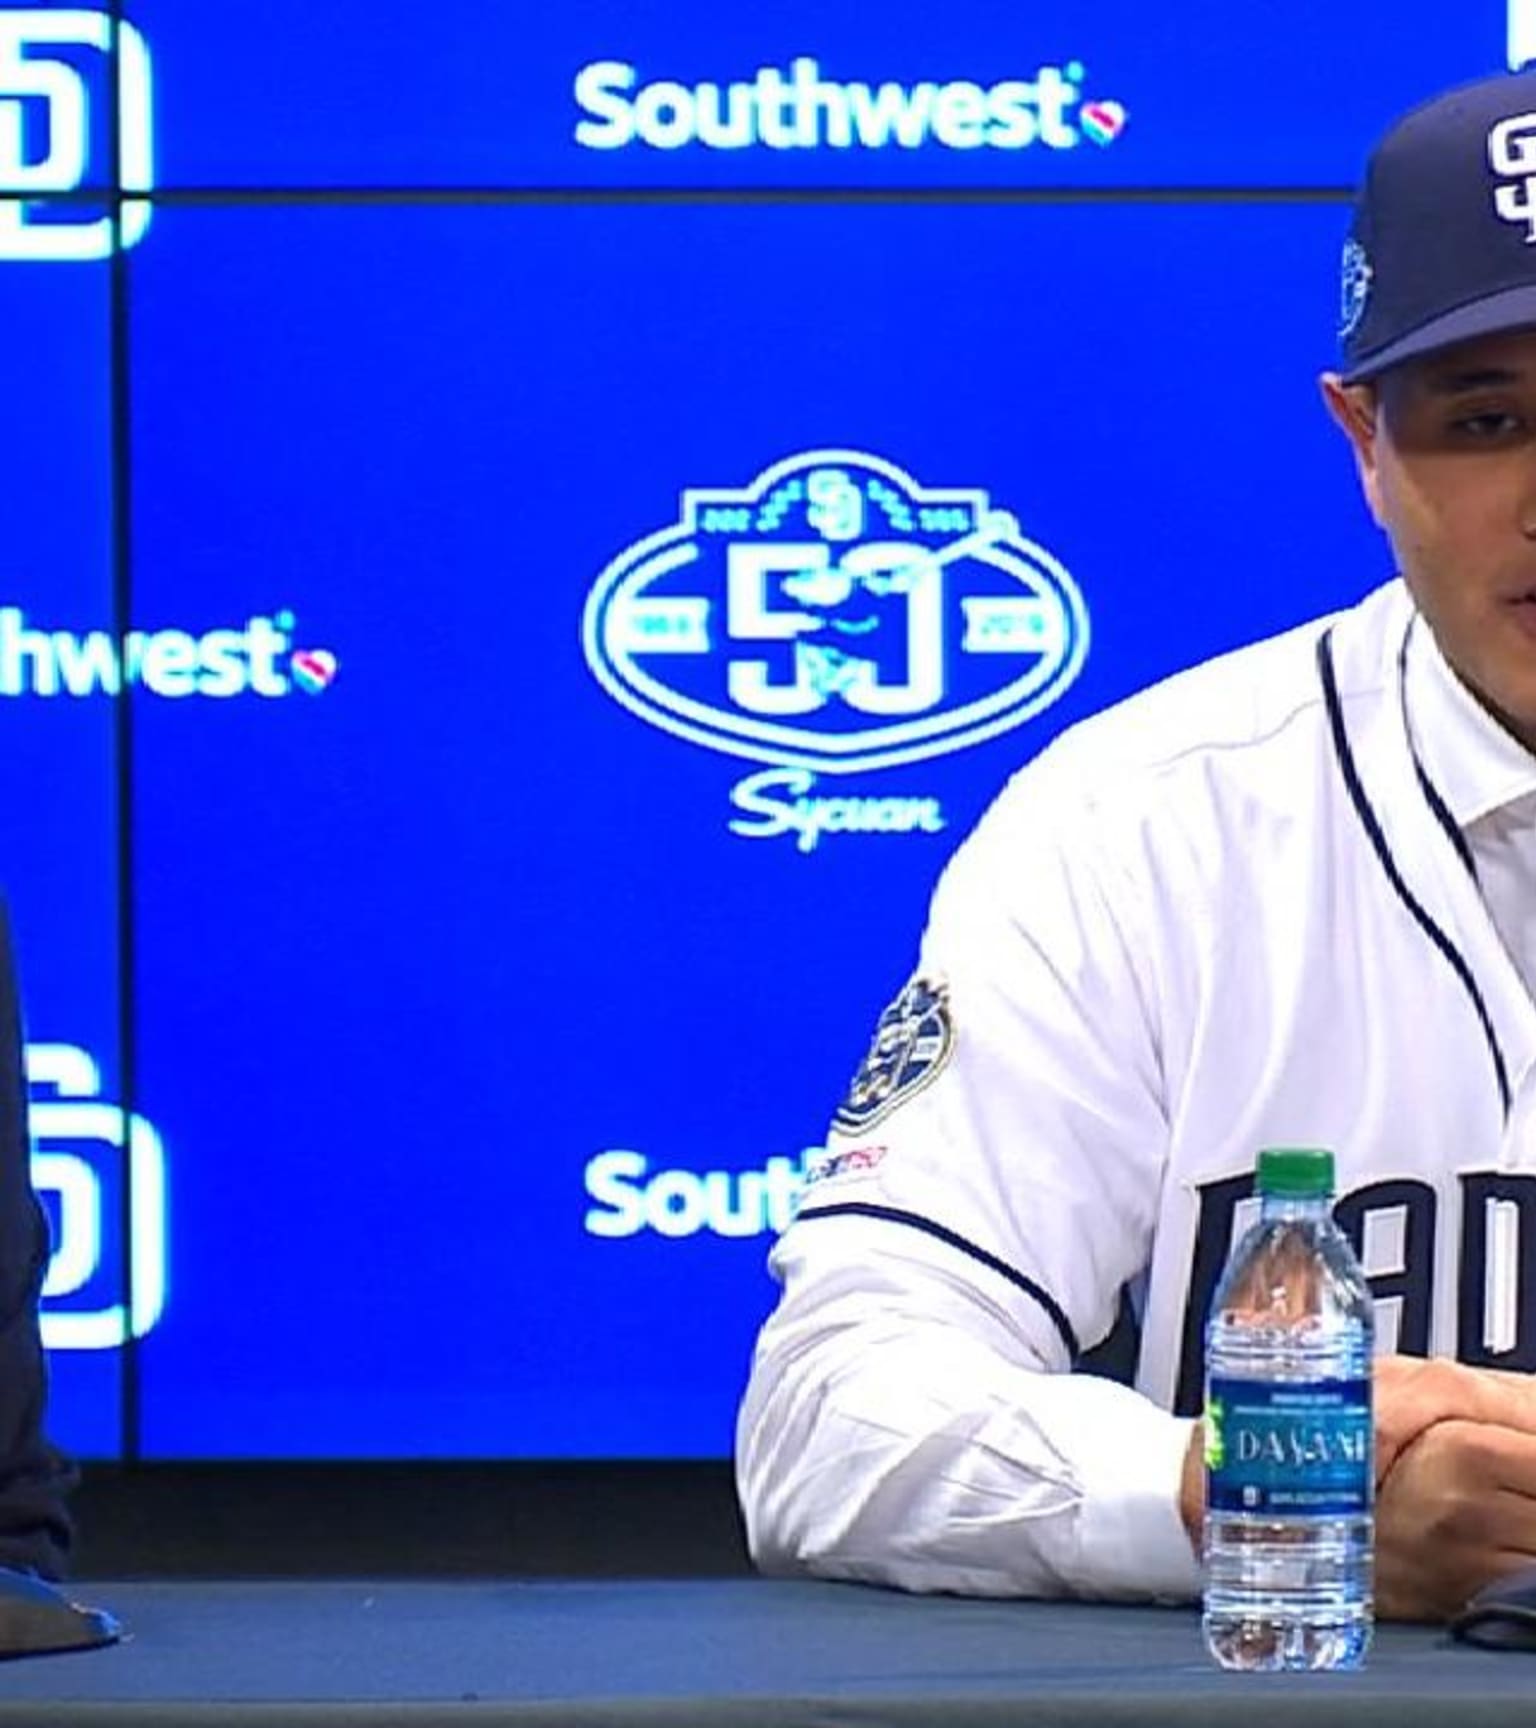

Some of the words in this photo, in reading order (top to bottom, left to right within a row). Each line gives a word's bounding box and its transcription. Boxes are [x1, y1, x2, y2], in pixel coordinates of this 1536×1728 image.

[576, 58, 1075, 148] Southwest
[728, 767, 946, 853] Sycuan
[584, 1149, 828, 1237] Sout
